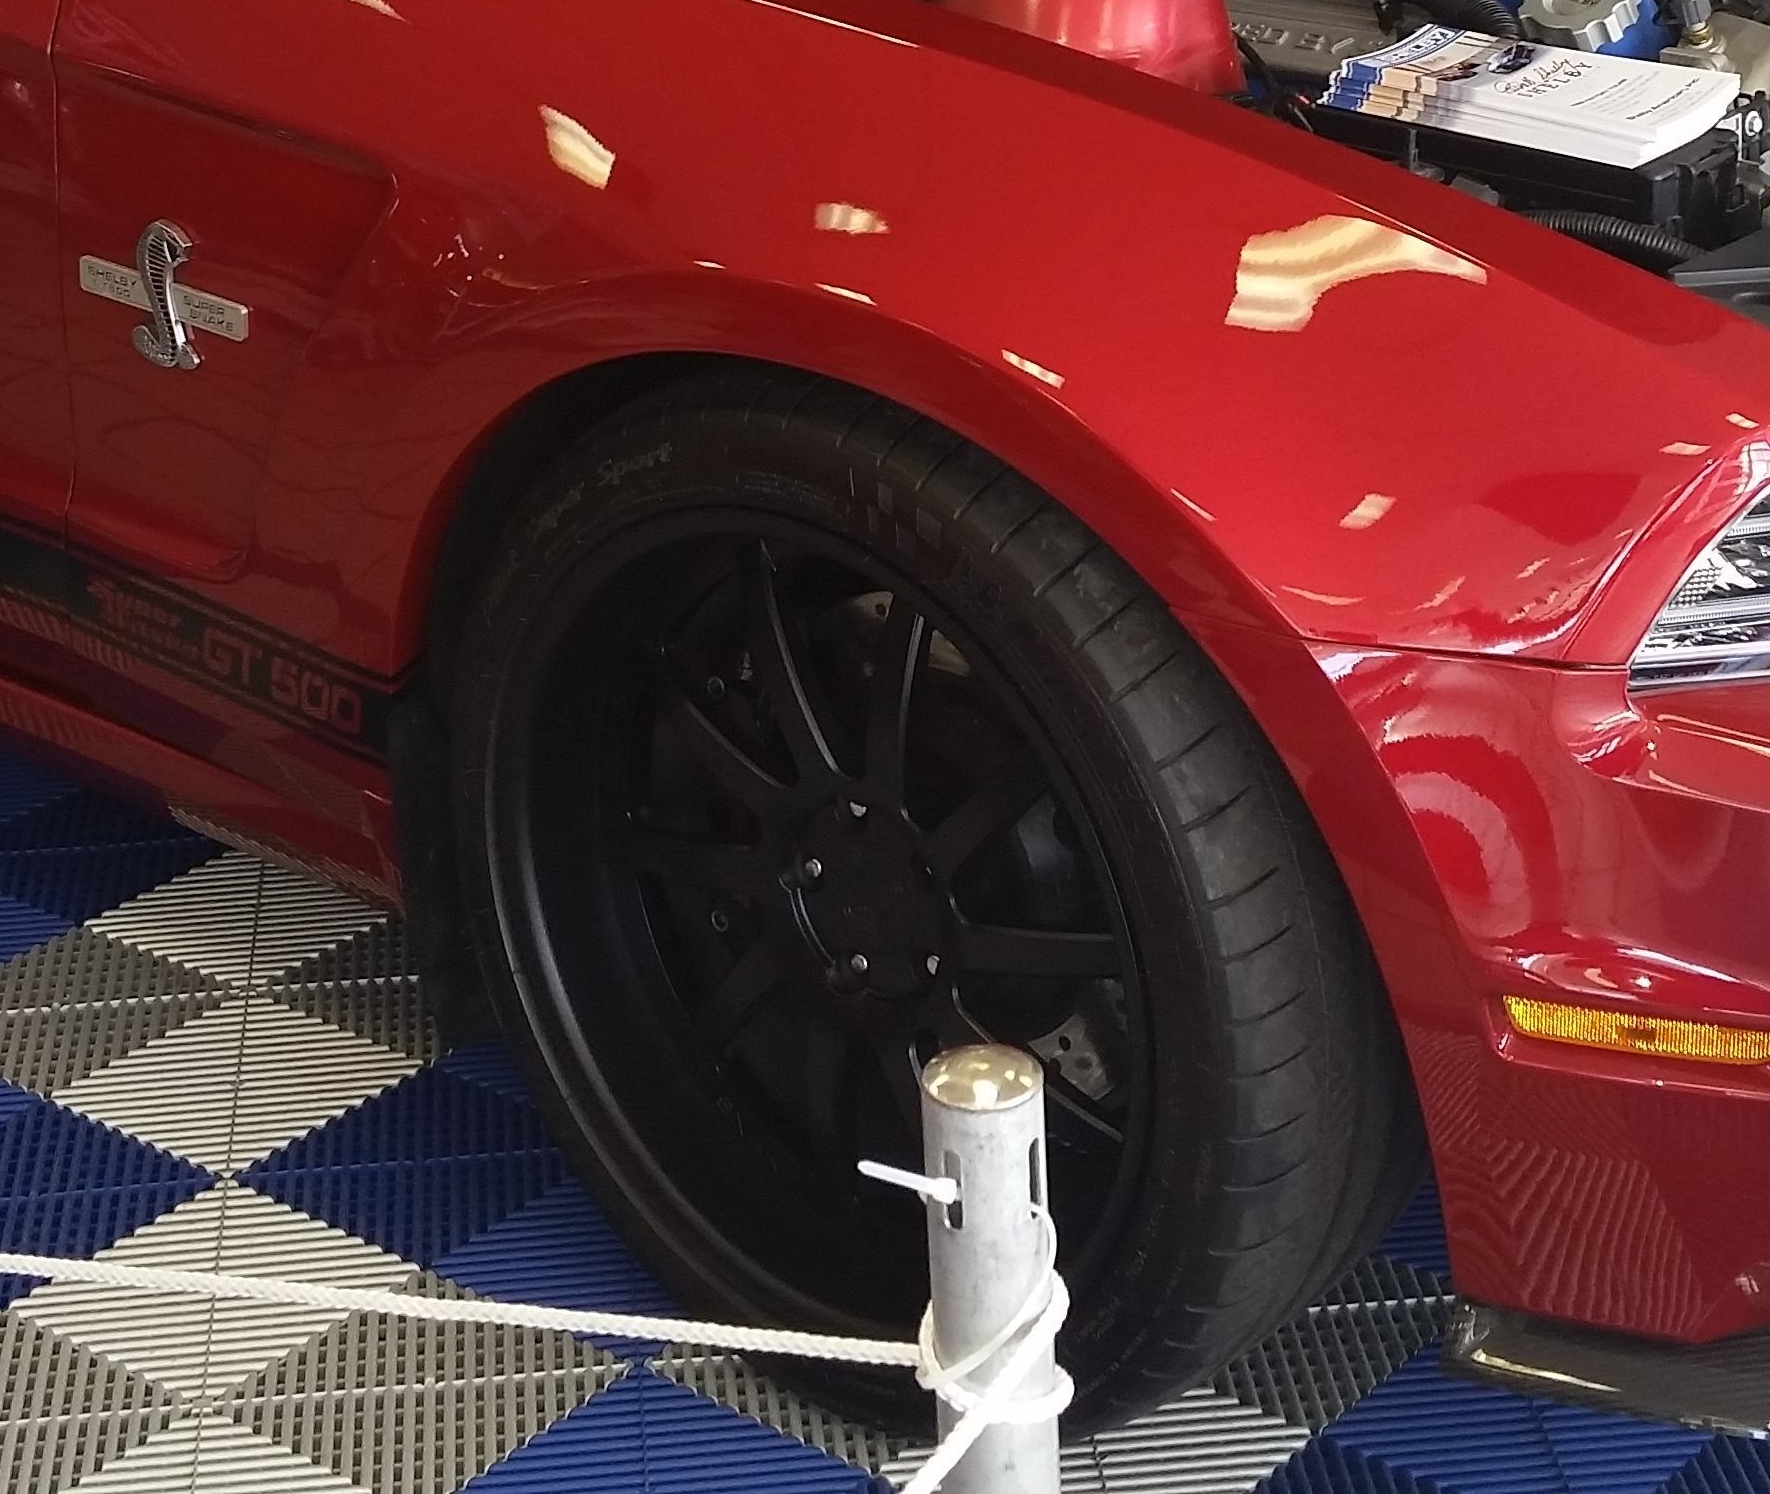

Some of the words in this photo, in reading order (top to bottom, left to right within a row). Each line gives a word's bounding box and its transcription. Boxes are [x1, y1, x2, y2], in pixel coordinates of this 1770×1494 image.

[86, 265, 138, 288] SHELBY
[182, 294, 226, 315] SUPER
[189, 309, 235, 333] SNAKE
[269, 656, 362, 734] 500
